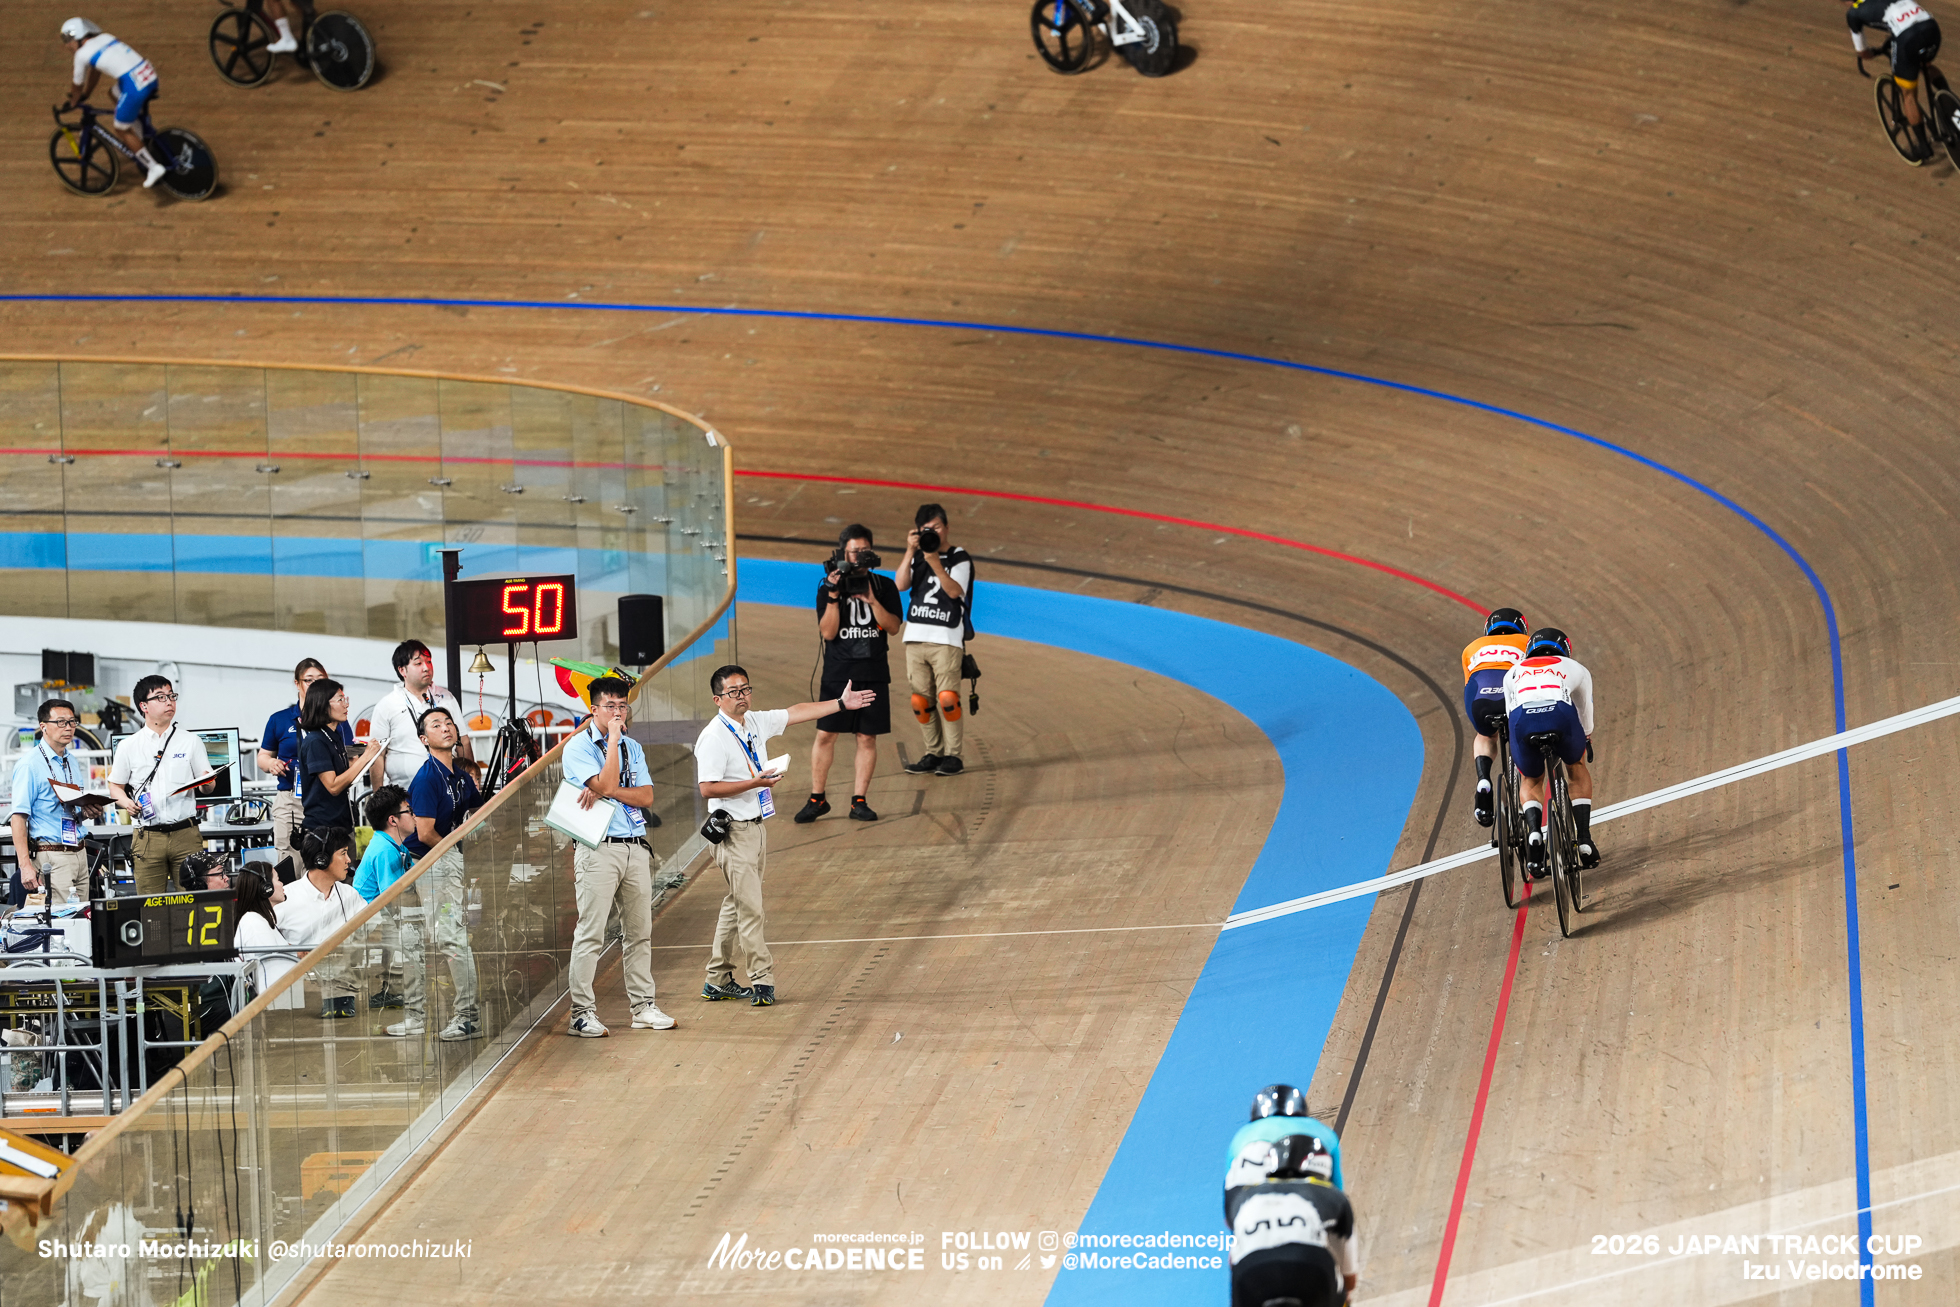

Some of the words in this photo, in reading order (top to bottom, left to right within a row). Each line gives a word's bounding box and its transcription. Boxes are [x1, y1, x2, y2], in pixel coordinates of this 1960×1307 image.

[923, 575, 941, 604] 2
[503, 583, 563, 635] 50
[911, 605, 951, 622] Official
[1515, 668, 1567, 683] JAPAN
[187, 905, 222, 946] 12
